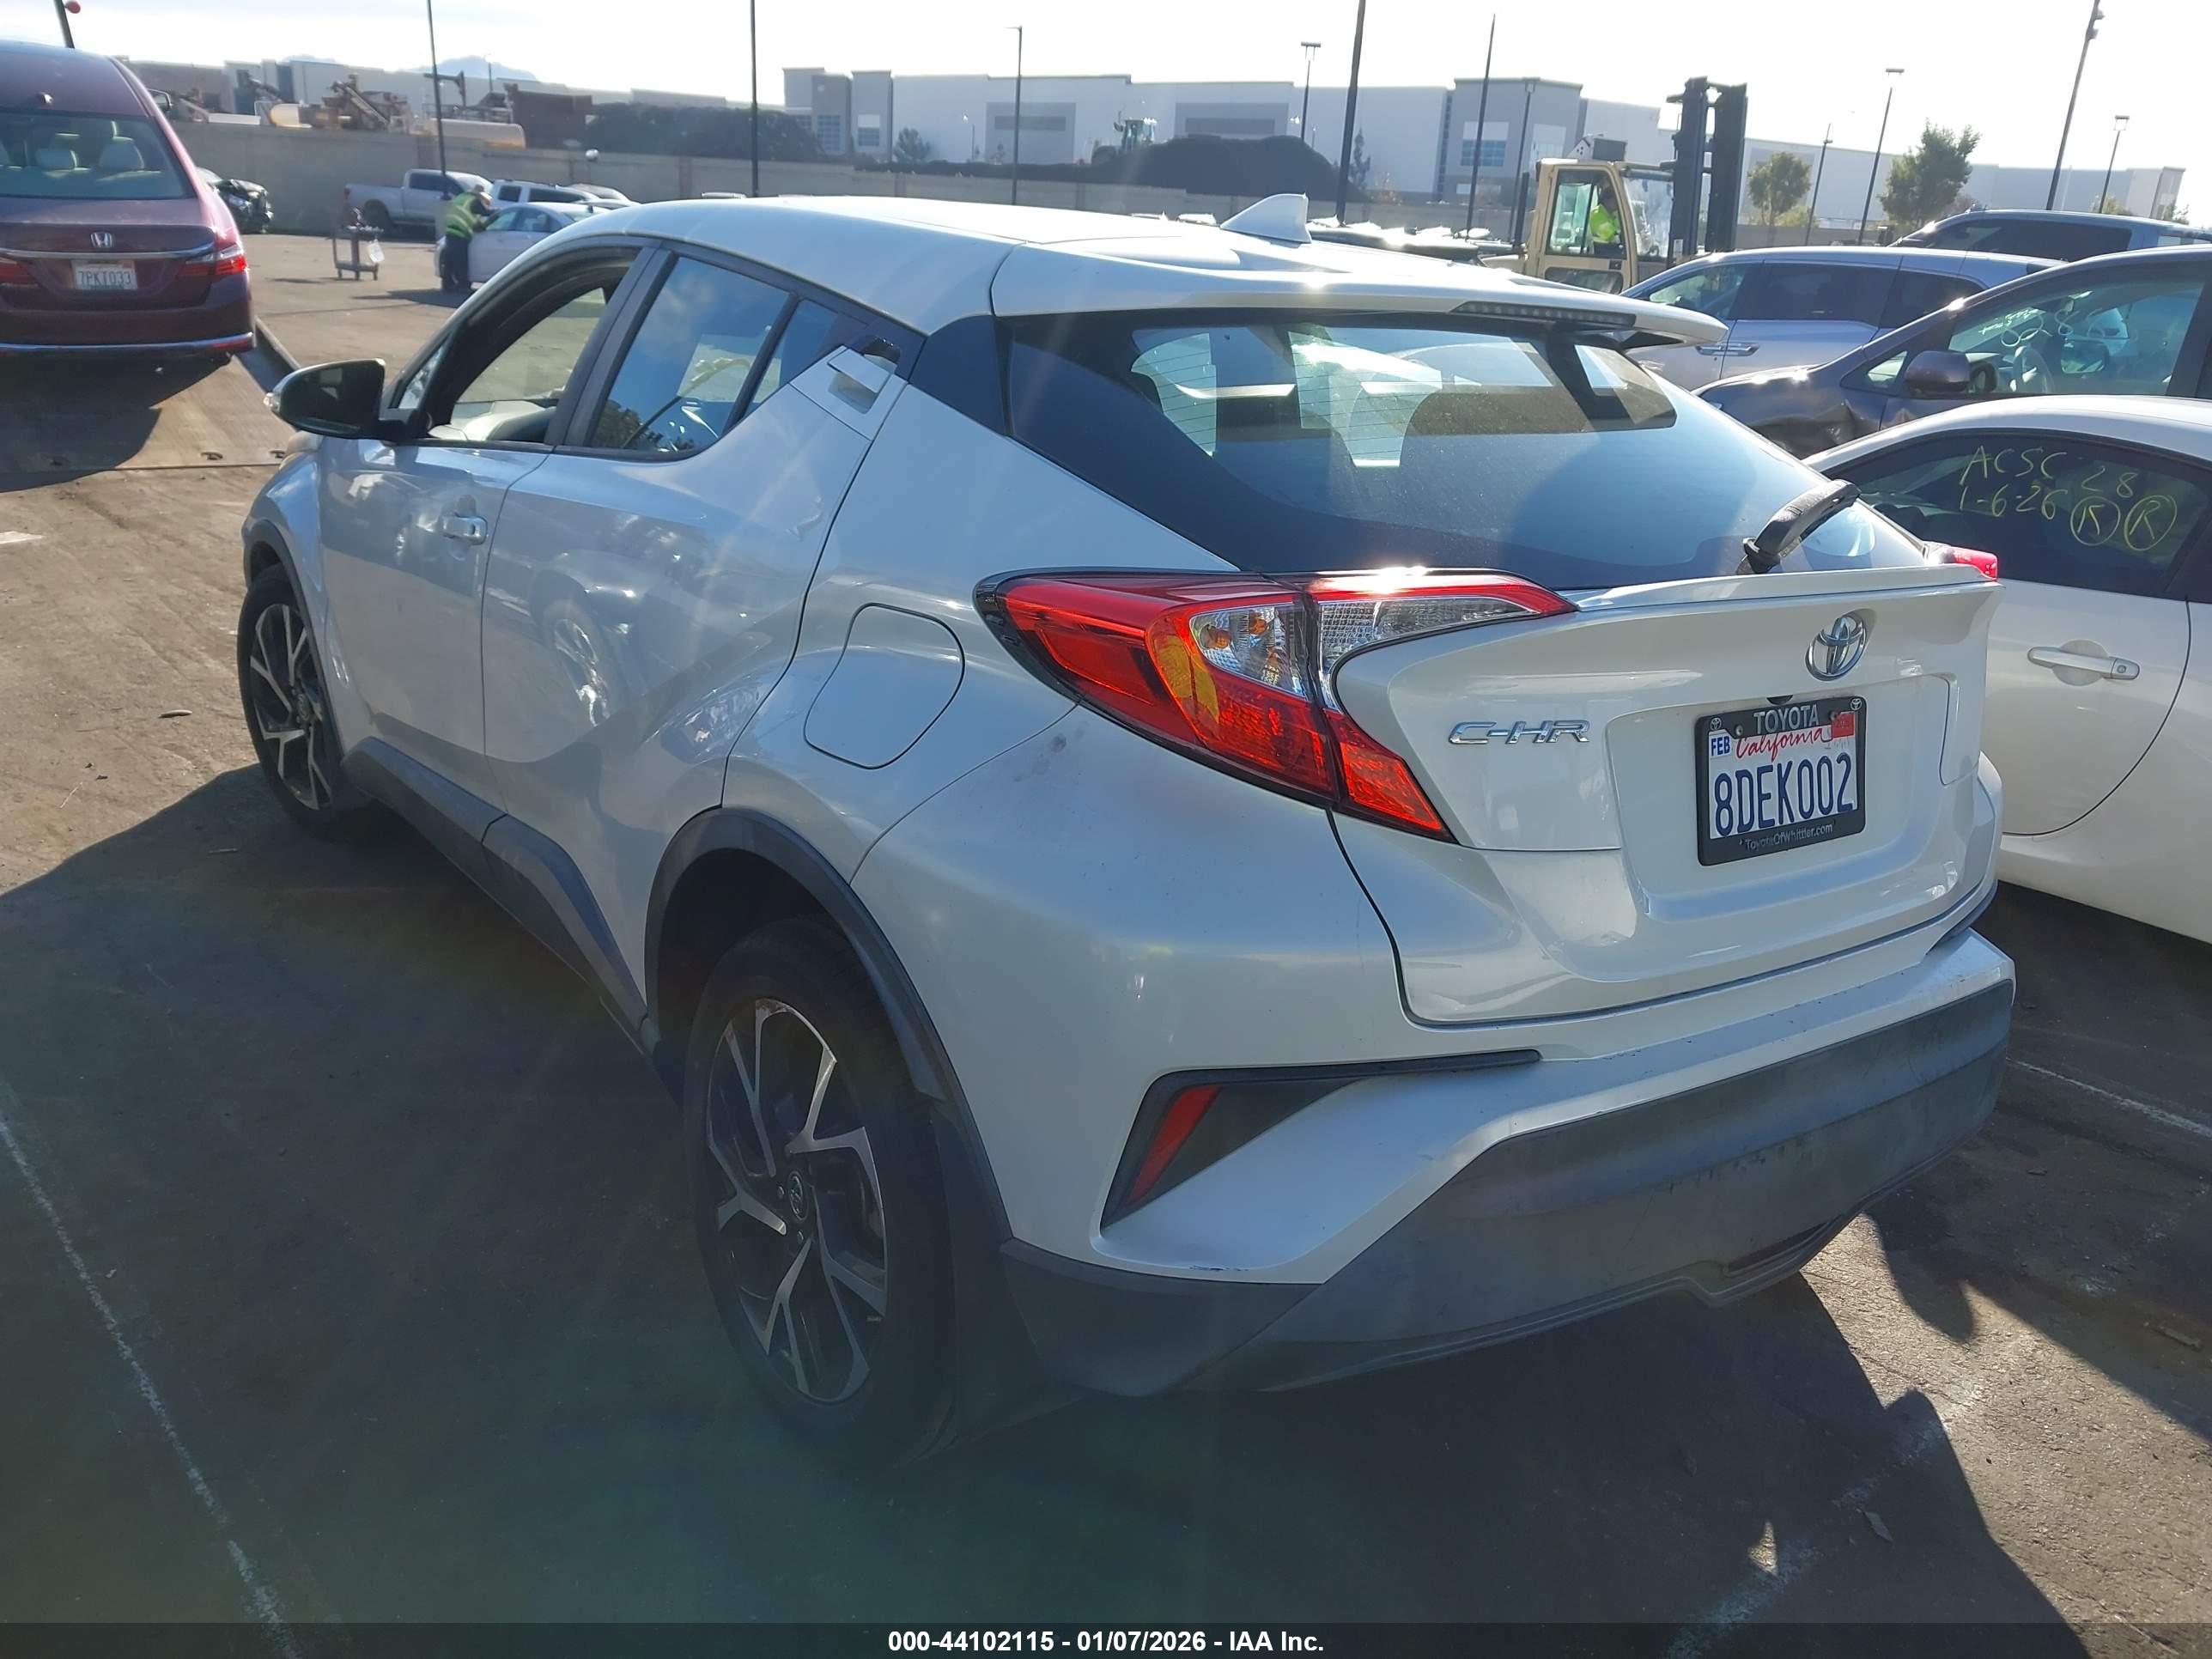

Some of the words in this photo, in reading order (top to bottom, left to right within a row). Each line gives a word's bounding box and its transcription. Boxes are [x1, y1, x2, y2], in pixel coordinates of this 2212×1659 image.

[1449, 720, 1590, 744] C-HR
[1753, 703, 1820, 734] TOYOTA
[1711, 735, 1730, 757] FEB
[1735, 726, 1832, 763] California
[1714, 751, 1853, 837] 8DEK002
